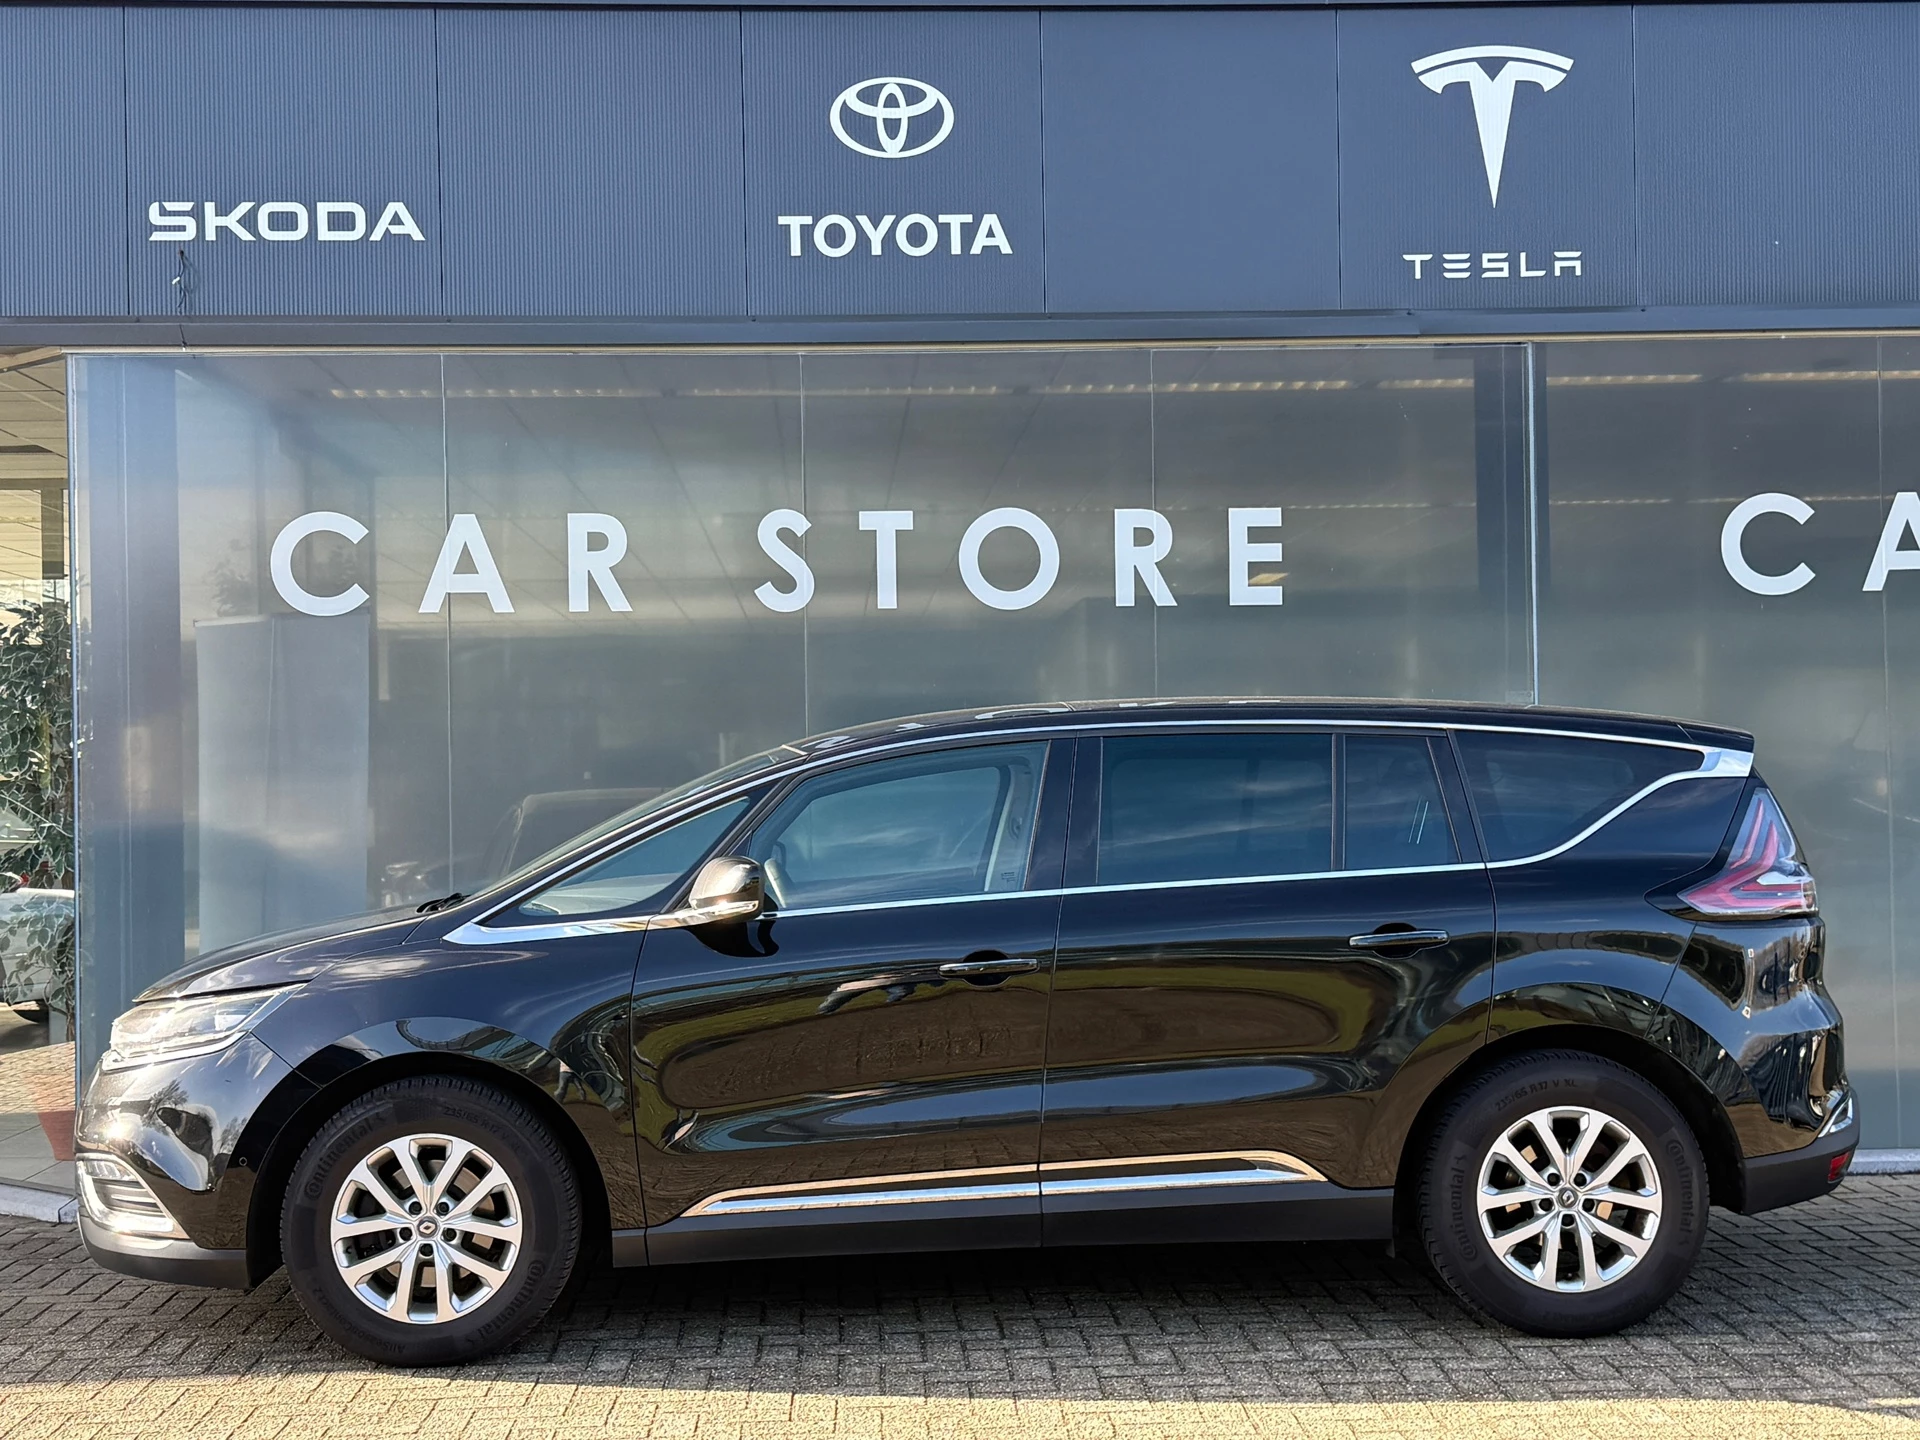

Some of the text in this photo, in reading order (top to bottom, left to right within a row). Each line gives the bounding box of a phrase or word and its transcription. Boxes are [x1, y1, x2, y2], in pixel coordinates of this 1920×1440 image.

[778, 214, 1013, 258] TOYOTA
[1402, 252, 1582, 280] TESLA
[270, 507, 1283, 616] CAR STORE
[1495, 1087, 1529, 1111] 235/65
[1564, 1079, 1578, 1088] XL
[304, 1117, 374, 1200] Continental
[1665, 1139, 1694, 1233] Continental
[1449, 1166, 1478, 1261] Continental
[477, 1259, 546, 1340] Continental
